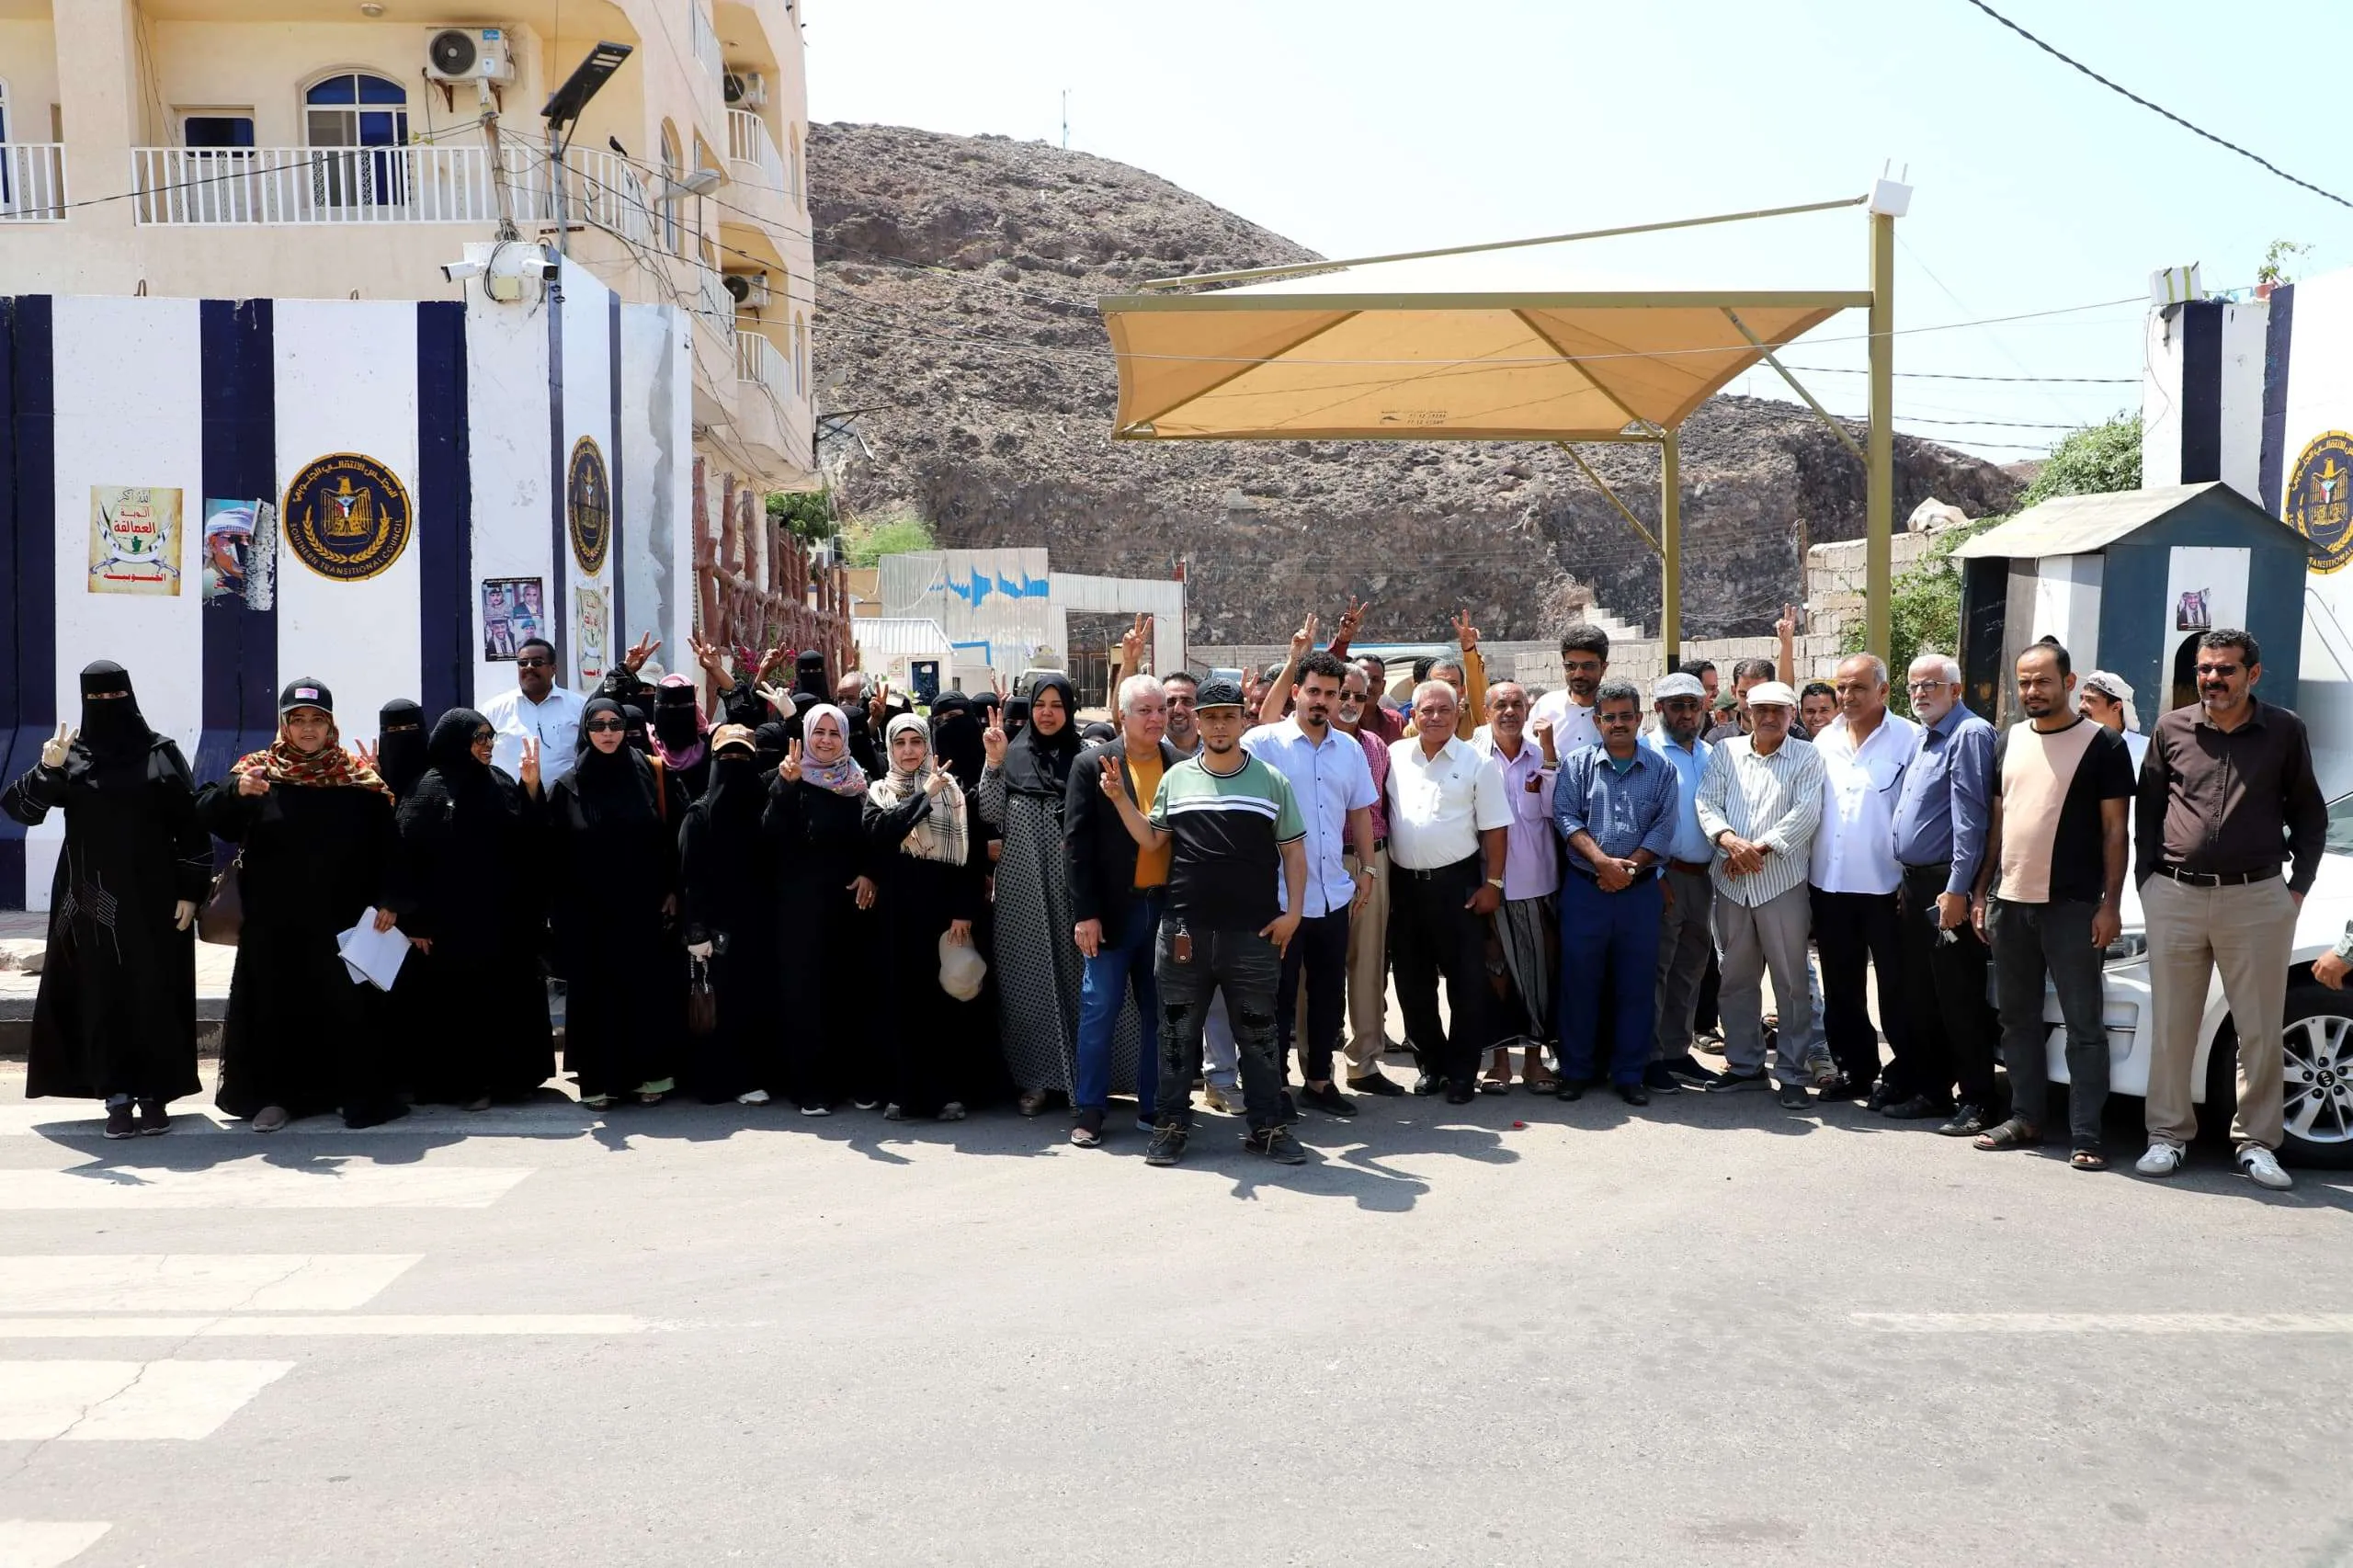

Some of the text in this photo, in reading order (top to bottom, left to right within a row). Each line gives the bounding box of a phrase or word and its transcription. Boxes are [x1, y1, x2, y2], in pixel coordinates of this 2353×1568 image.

[114, 520, 156, 534] العمالقة
[290, 517, 403, 575] SOUTHERN TRANSITIONAL COUNCIL
[2309, 547, 2353, 567] RANSITIONAL
